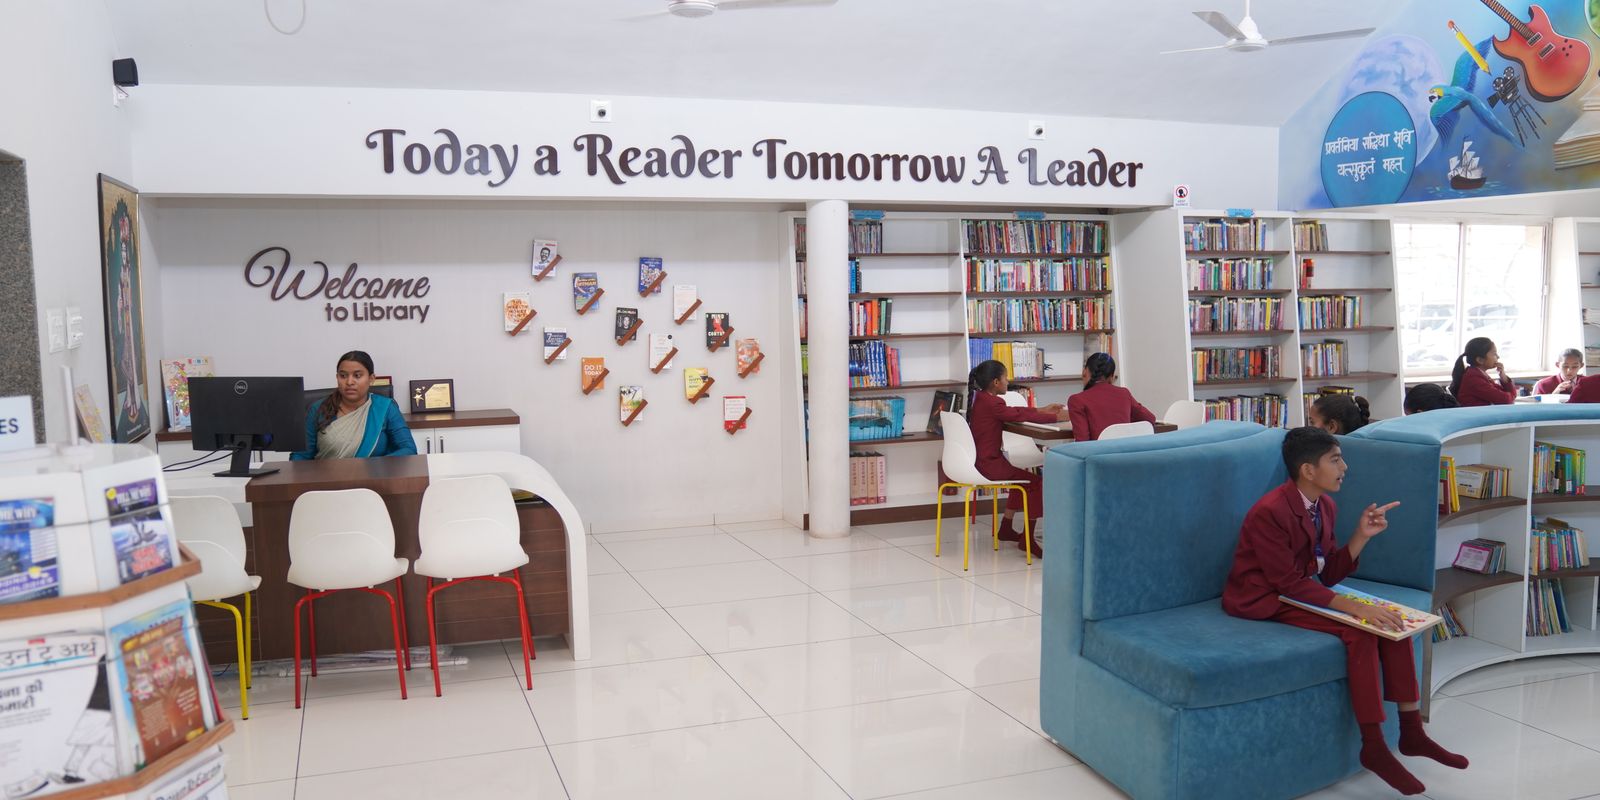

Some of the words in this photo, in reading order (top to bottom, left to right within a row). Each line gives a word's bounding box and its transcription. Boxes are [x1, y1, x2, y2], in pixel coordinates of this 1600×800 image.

[365, 128, 518, 187] Today
[534, 145, 561, 176] a
[573, 133, 742, 185] Reader
[752, 138, 966, 183] Tomorrow
[971, 145, 1009, 186] A
[1017, 147, 1143, 188] Leader
[244, 246, 431, 301] Welcome
[325, 302, 348, 322] to
[353, 302, 430, 323] Library
[0, 418, 19, 434] ES
